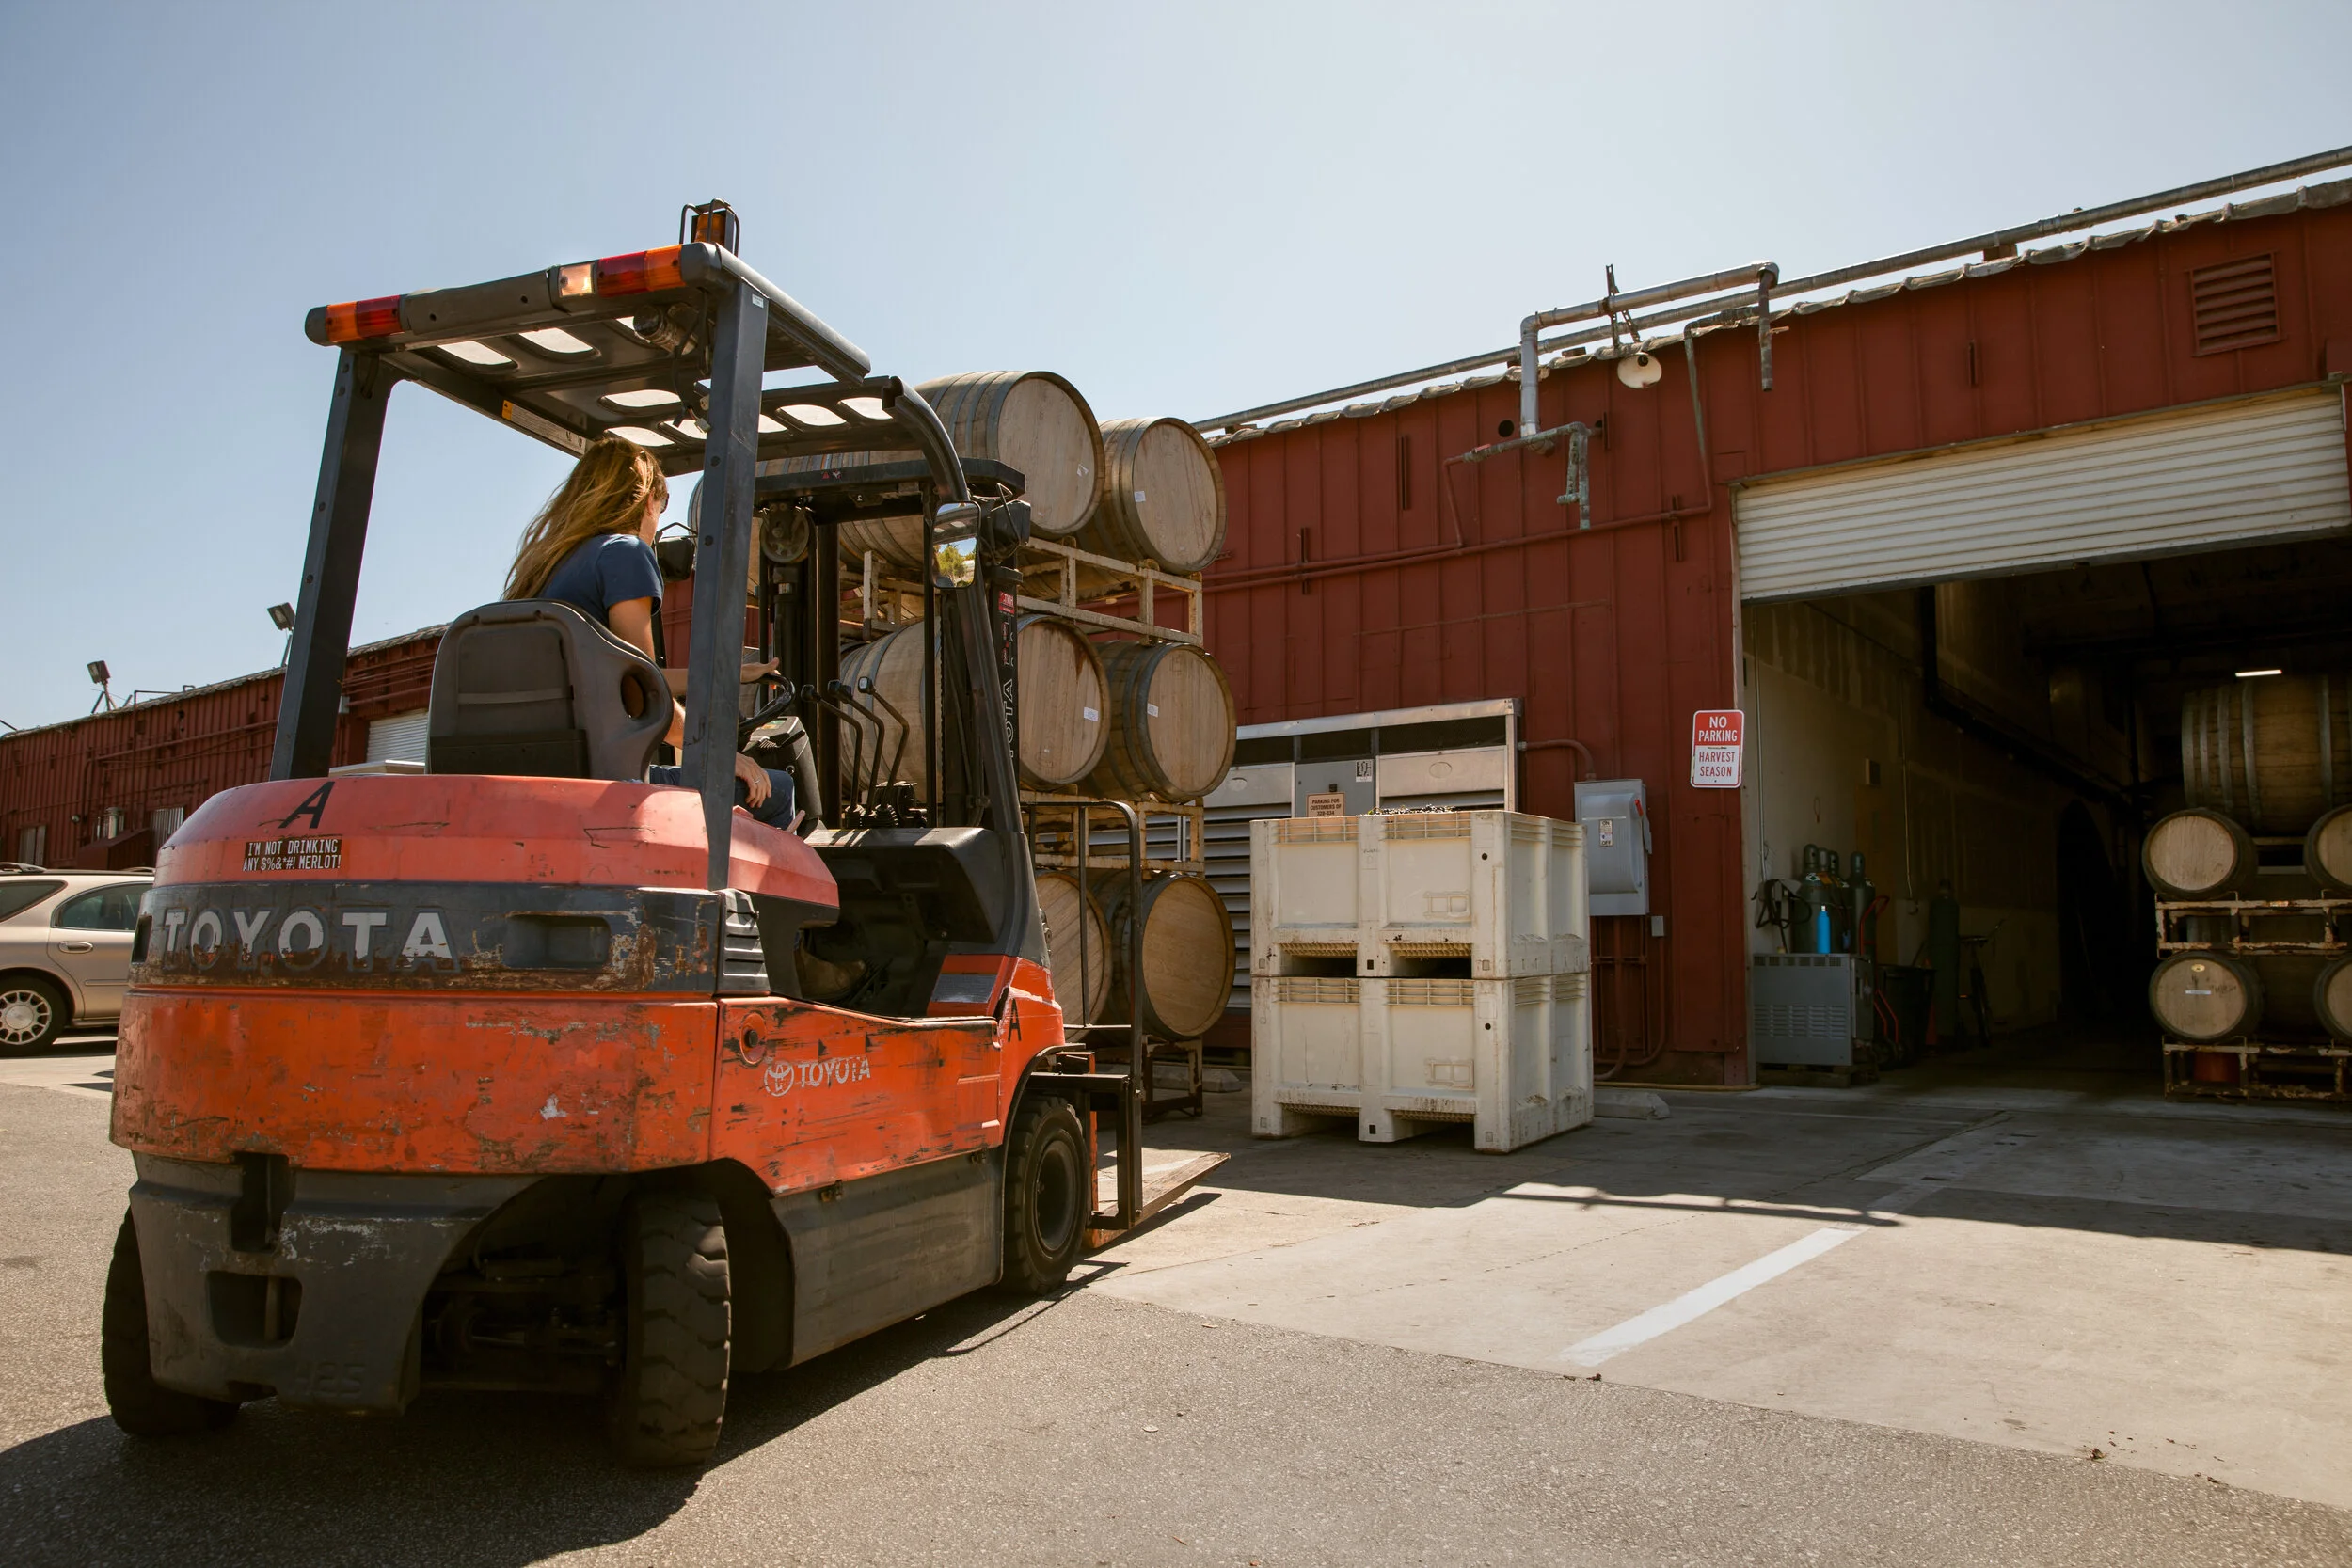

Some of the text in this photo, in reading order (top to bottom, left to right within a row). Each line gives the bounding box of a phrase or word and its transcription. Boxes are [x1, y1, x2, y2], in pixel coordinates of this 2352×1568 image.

[1709, 716, 1727, 728] NO
[1698, 730, 1738, 742] PARKING
[1699, 752, 1736, 763] HARVEST
[1699, 766, 1733, 777] SEASON
[278, 782, 335, 830] A
[248, 839, 338, 856] I'M NOT DRINKING
[243, 857, 259, 871] ANY
[298, 854, 342, 870] MERLOT!
[164, 906, 458, 969] TOYOTA
[1008, 998, 1022, 1042] A
[798, 1056, 871, 1088] TOYOTA
